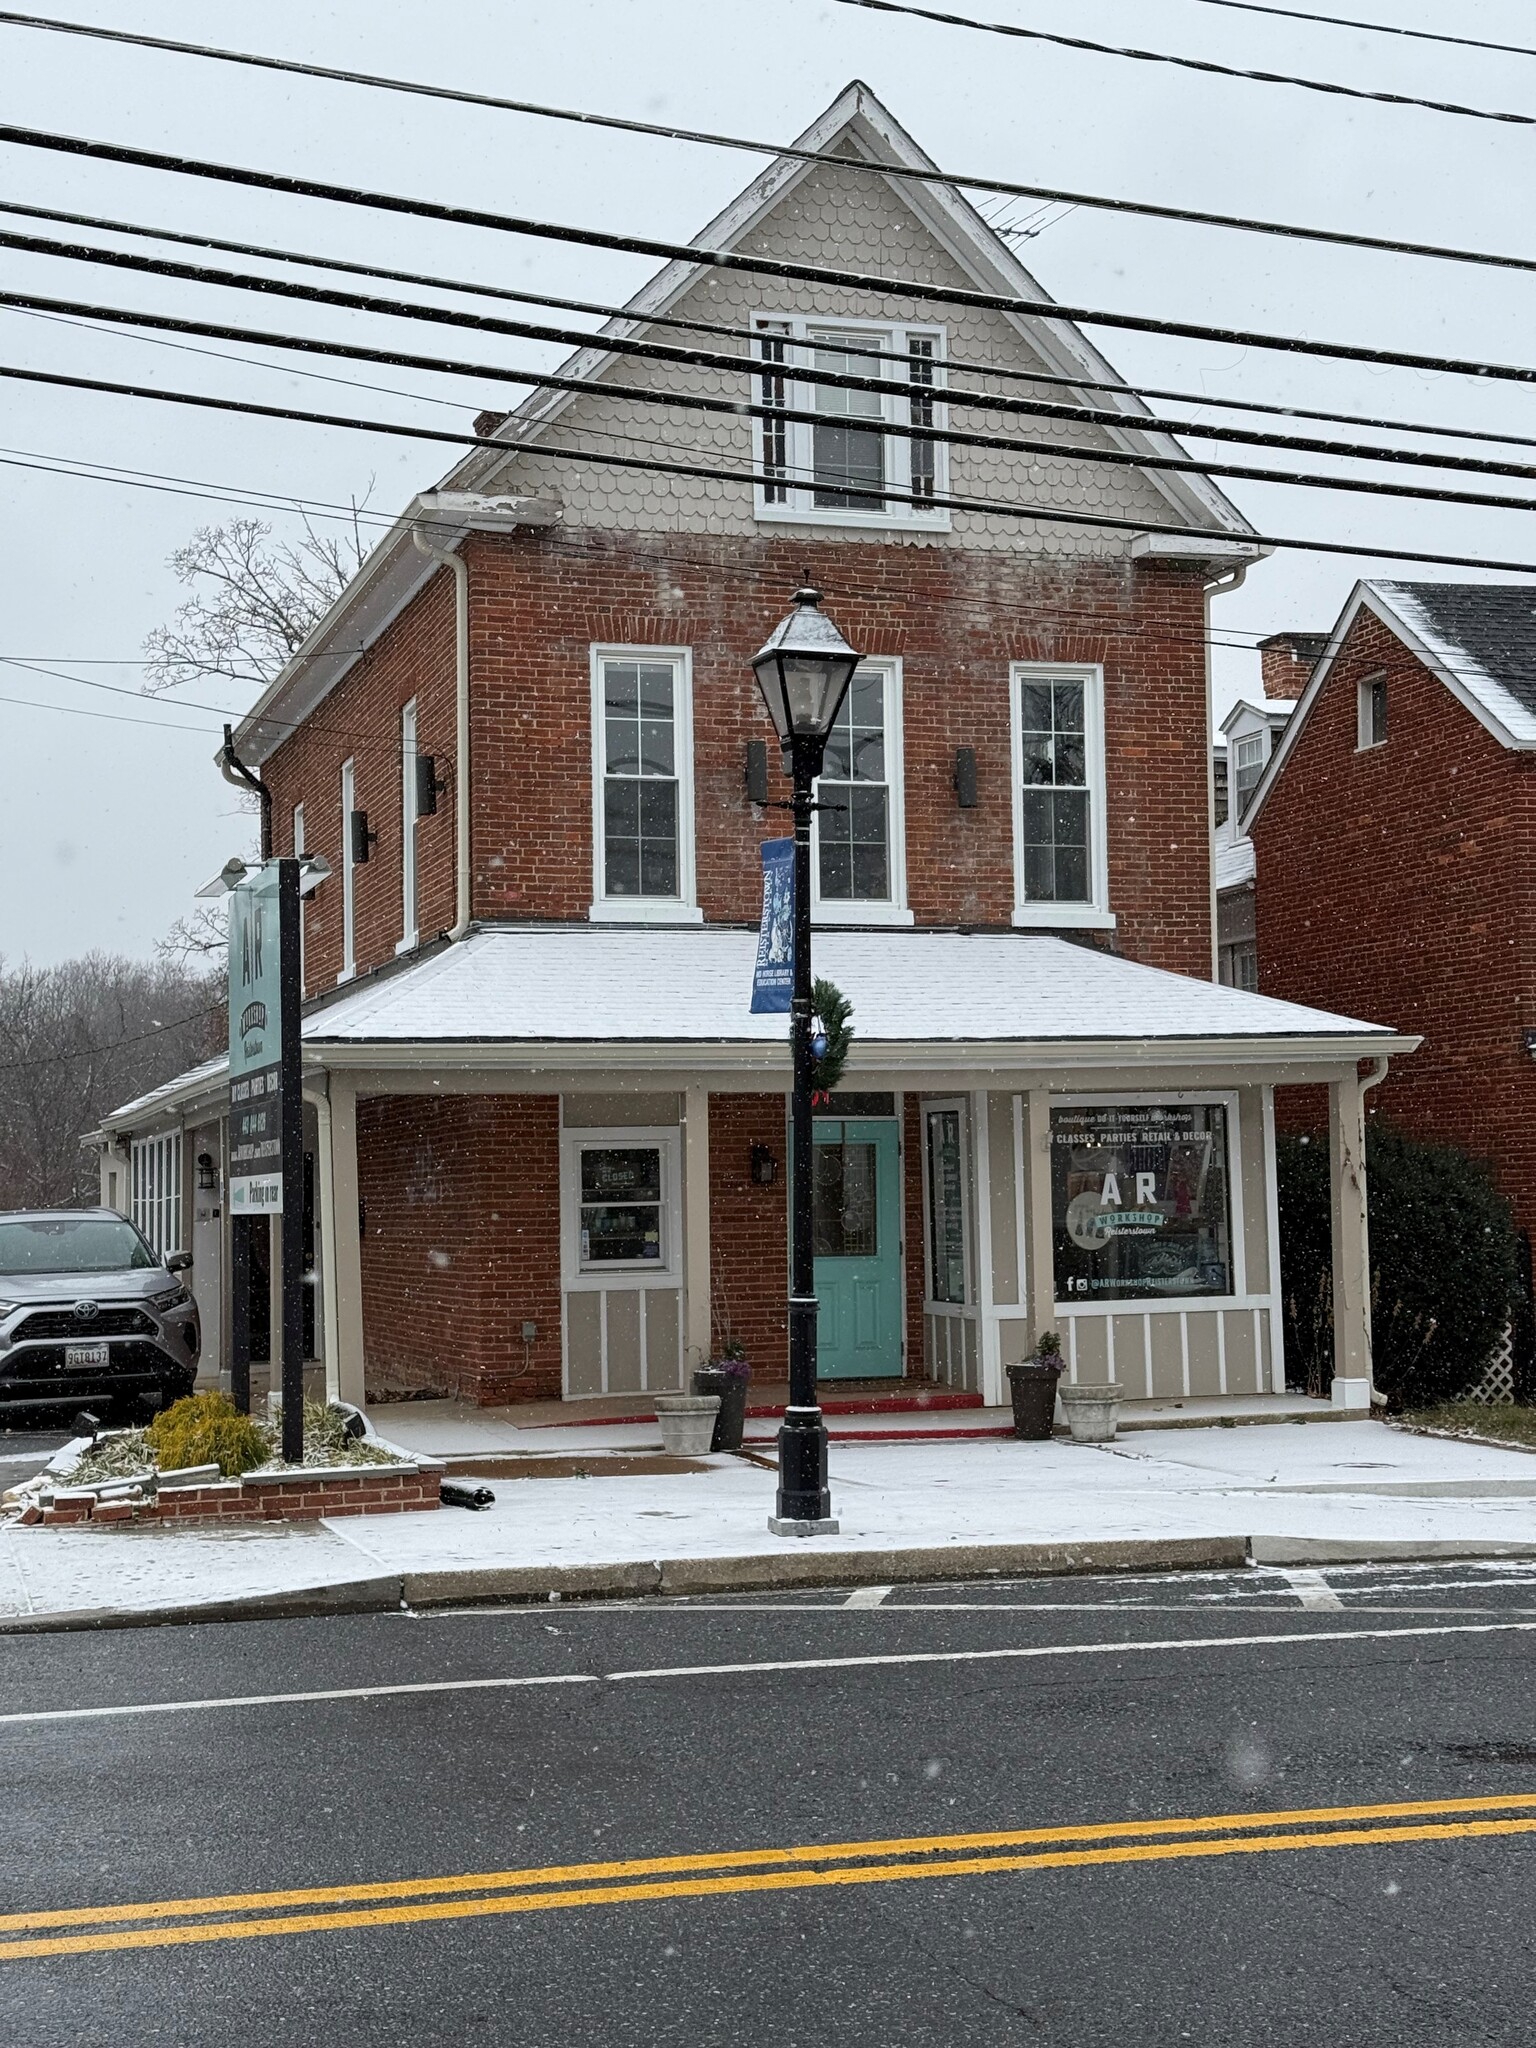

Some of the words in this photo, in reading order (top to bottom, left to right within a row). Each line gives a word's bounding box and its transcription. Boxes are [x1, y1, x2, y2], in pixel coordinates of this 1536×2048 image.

[757, 870, 773, 968] REISTERSTOWN
[1058, 1114, 1096, 1125] boutique
[1056, 1133, 1095, 1144] CLASSES
[1100, 1132, 1137, 1143] PARTIES
[1142, 1131, 1171, 1142] RETAIL
[1174, 1131, 1180, 1141] &
[1183, 1131, 1213, 1141] DECOR
[602, 1170, 634, 1182] CLOSED
[250, 1181, 264, 1207] Parking
[269, 1185, 279, 1203] rear
[1100, 1213, 1161, 1226] WORKSHOP
[1104, 1226, 1157, 1238] Reisterstown
